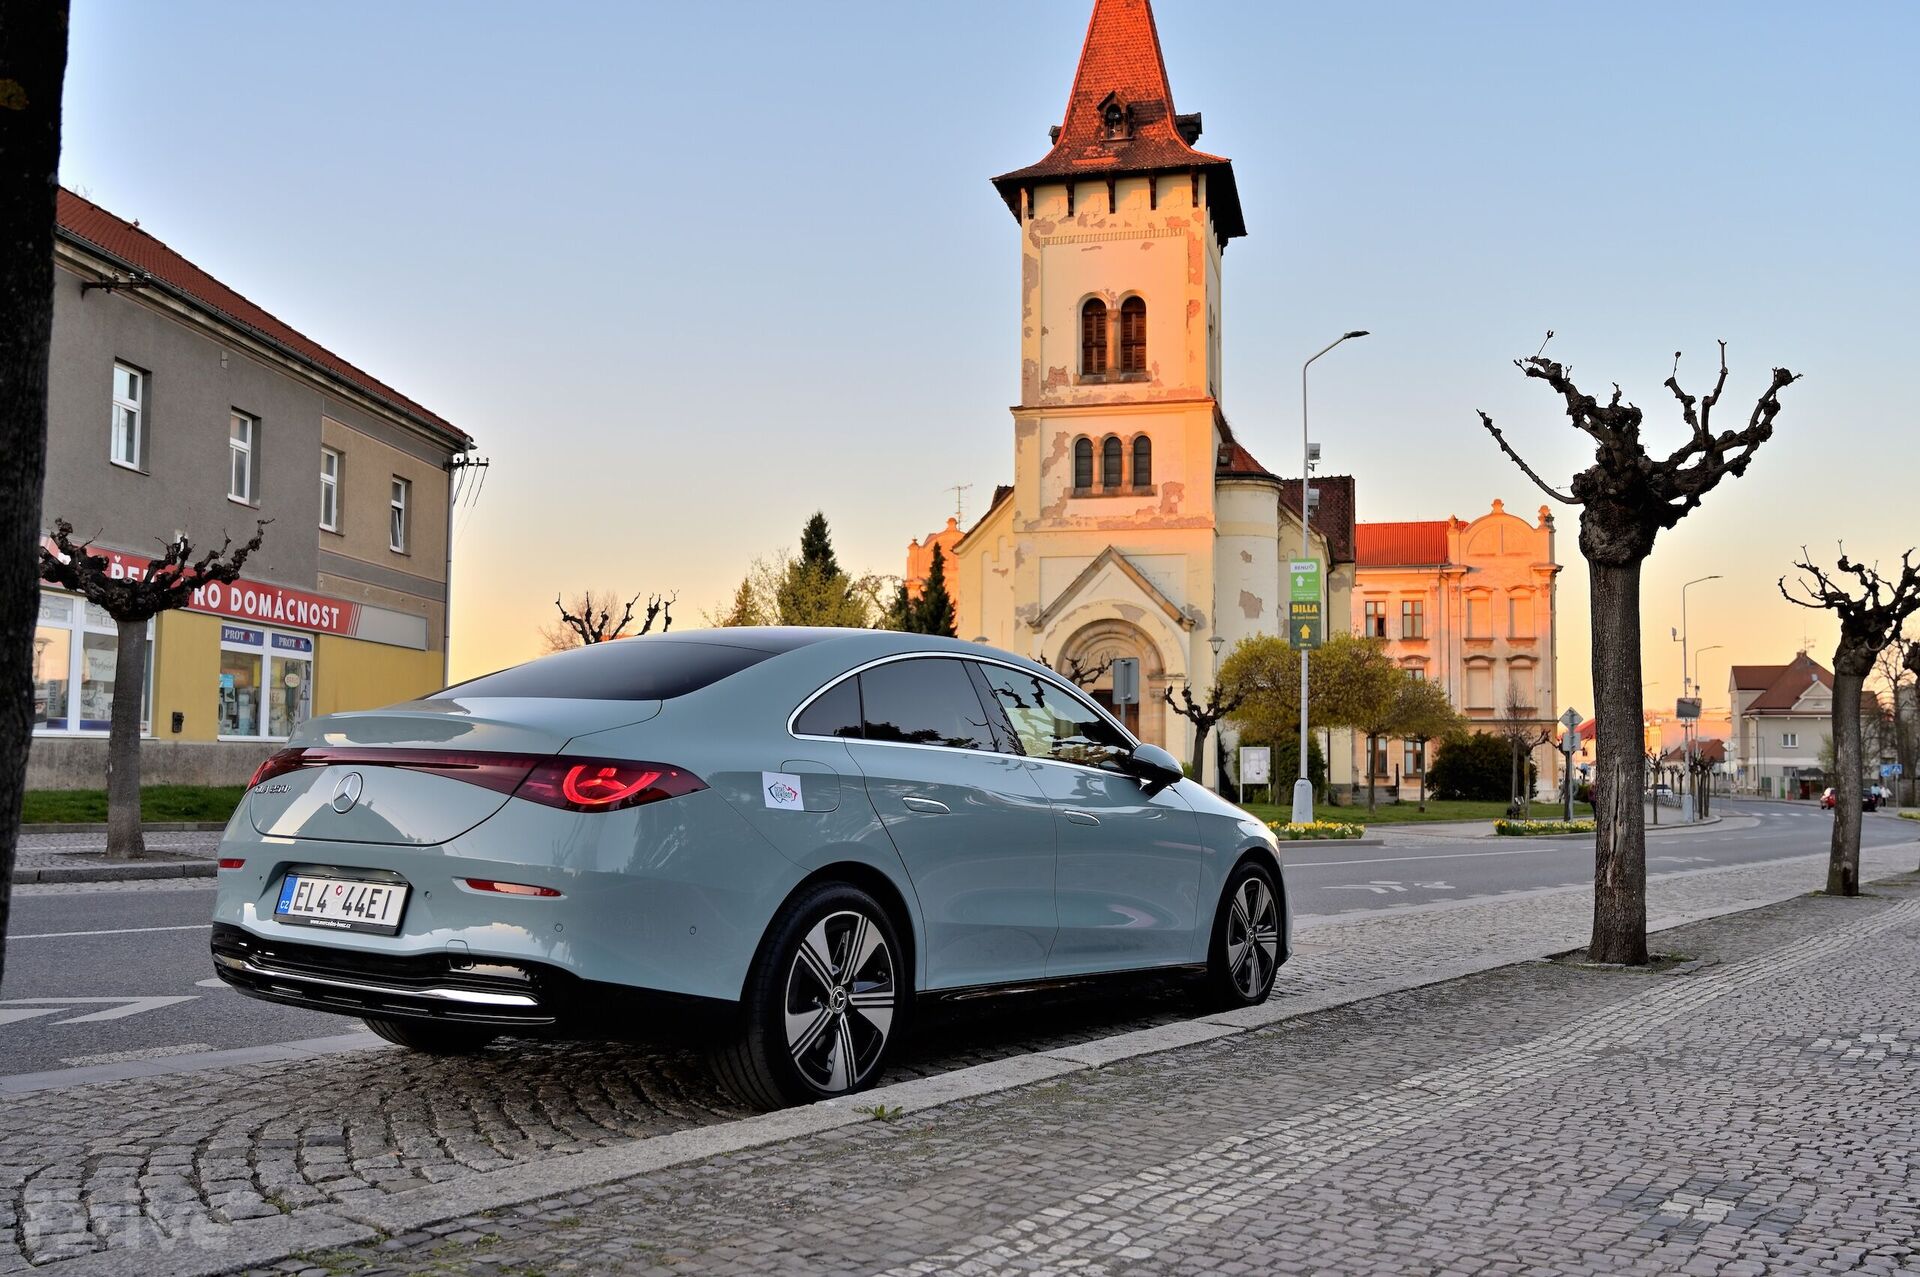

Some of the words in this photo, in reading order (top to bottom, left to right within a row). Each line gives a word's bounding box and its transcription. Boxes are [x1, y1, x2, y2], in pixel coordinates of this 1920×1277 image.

[188, 582, 221, 608] RO
[230, 588, 339, 629] DOMÁCNOST
[1292, 604, 1317, 613] BILLA
[280, 900, 289, 909] CZ
